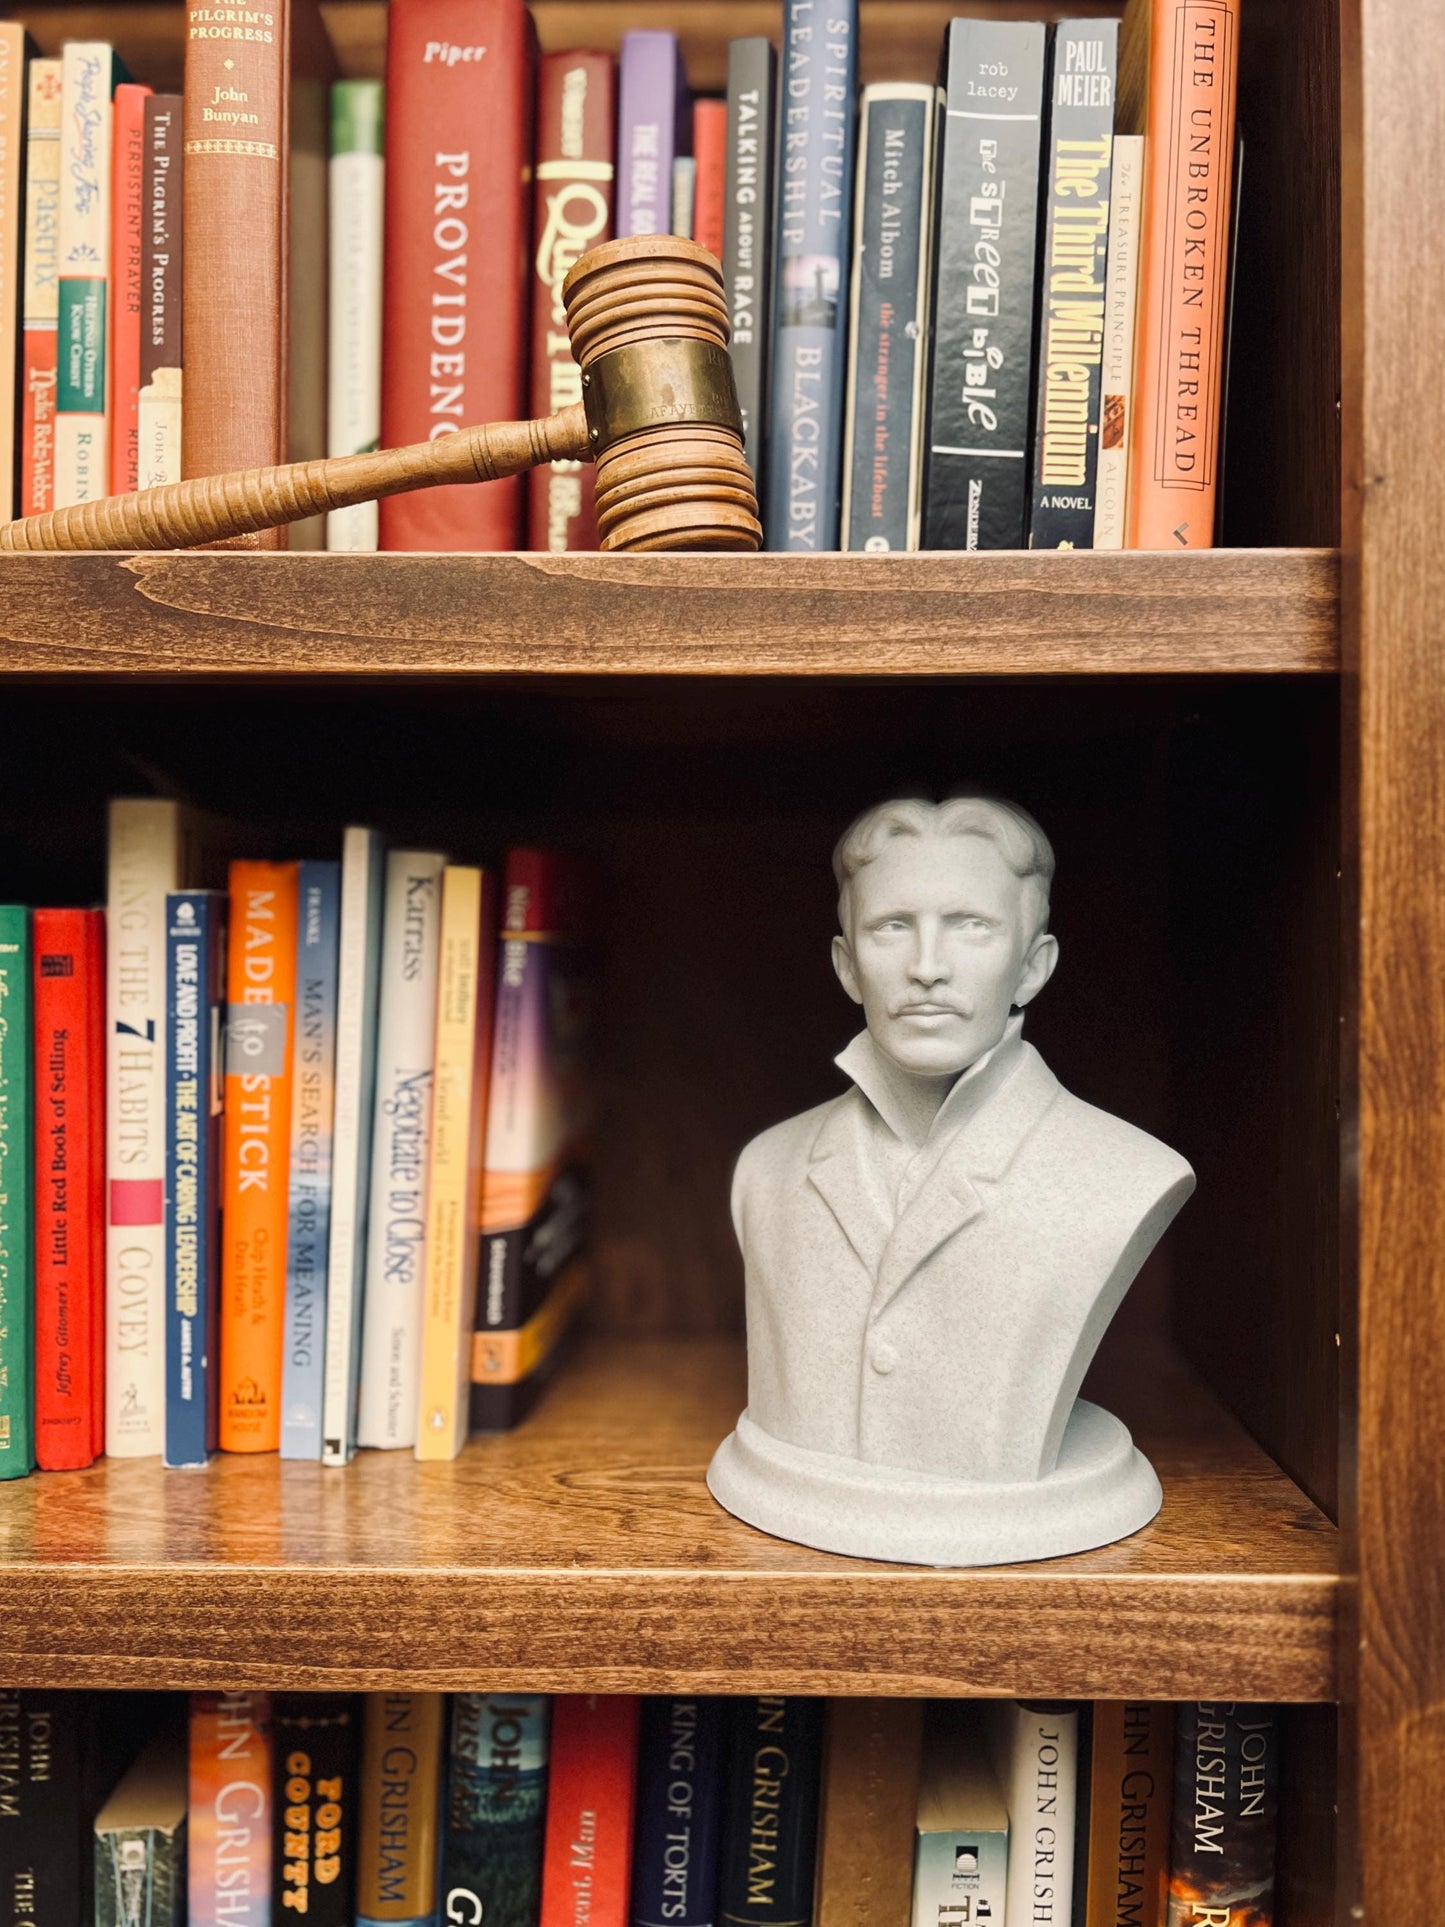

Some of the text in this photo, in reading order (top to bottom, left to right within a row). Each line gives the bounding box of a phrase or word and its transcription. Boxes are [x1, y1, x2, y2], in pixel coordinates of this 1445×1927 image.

[190, 9, 274, 26] PILGRIM'S
[190, 27, 273, 43] PROGRESS
[423, 41, 487, 67] Piper
[1065, 41, 1107, 72] PAUL
[211, 86, 248, 105] John
[967, 81, 1018, 101] lacey
[978, 62, 1009, 77] rob
[1057, 74, 1111, 107] MEIER
[203, 107, 259, 126] Bunyan
[783, 2, 815, 245] LEADERSHIP
[817, 18, 850, 226] SPIRITUAL
[126, 129, 142, 313] PERSISTENT PRAYER
[151, 112, 171, 346] THE PILGRIM'S PROGRESS
[733, 89, 759, 345] TALKING ABOUT RACE
[879, 129, 905, 279] Mitch Albom
[1114, 193, 1132, 284] TREASURE
[1175, 18, 1216, 472] THE UNBROKEN THREAD
[1041, 134, 1113, 486] The Third Millennium
[1109, 290, 1127, 382] PRINCIPLE
[788, 346, 822, 547] BLACKABY
[1041, 496, 1093, 510] A NOVEL
[1101, 462, 1118, 537] ALCORN
[243, 891, 275, 1005] MADE
[403, 874, 434, 983] Karrass
[119, 950, 149, 1006] THE
[50, 1029, 69, 1091] Selling
[116, 1019, 156, 1042] 7
[50, 1097, 66, 1114] of
[51, 1115, 67, 1171] Book
[119, 1048, 153, 1165] HABITS
[238, 1072, 272, 1192] STICK
[52, 1175, 69, 1214] Red
[292, 978, 325, 1369] MAN'S SEARCH FOR MEANING
[53, 1217, 69, 1267] Little
[176, 1225, 198, 1317] LEADERSHIP
[117, 1246, 152, 1357] COVEY
[27, 1711, 50, 1781] JOHN
[1036, 1727, 1060, 1816] JOHN
[1236, 1720, 1273, 1817] JOHN
[282, 1751, 312, 1914] COUNTY
[314, 1776, 343, 1885] FORD
[377, 1747, 417, 1904] GRISHAM
[569, 1811, 598, 1869] Man
[660, 1703, 698, 1919] KING OF TORTS
[747, 1746, 790, 1906] GRISHAM
